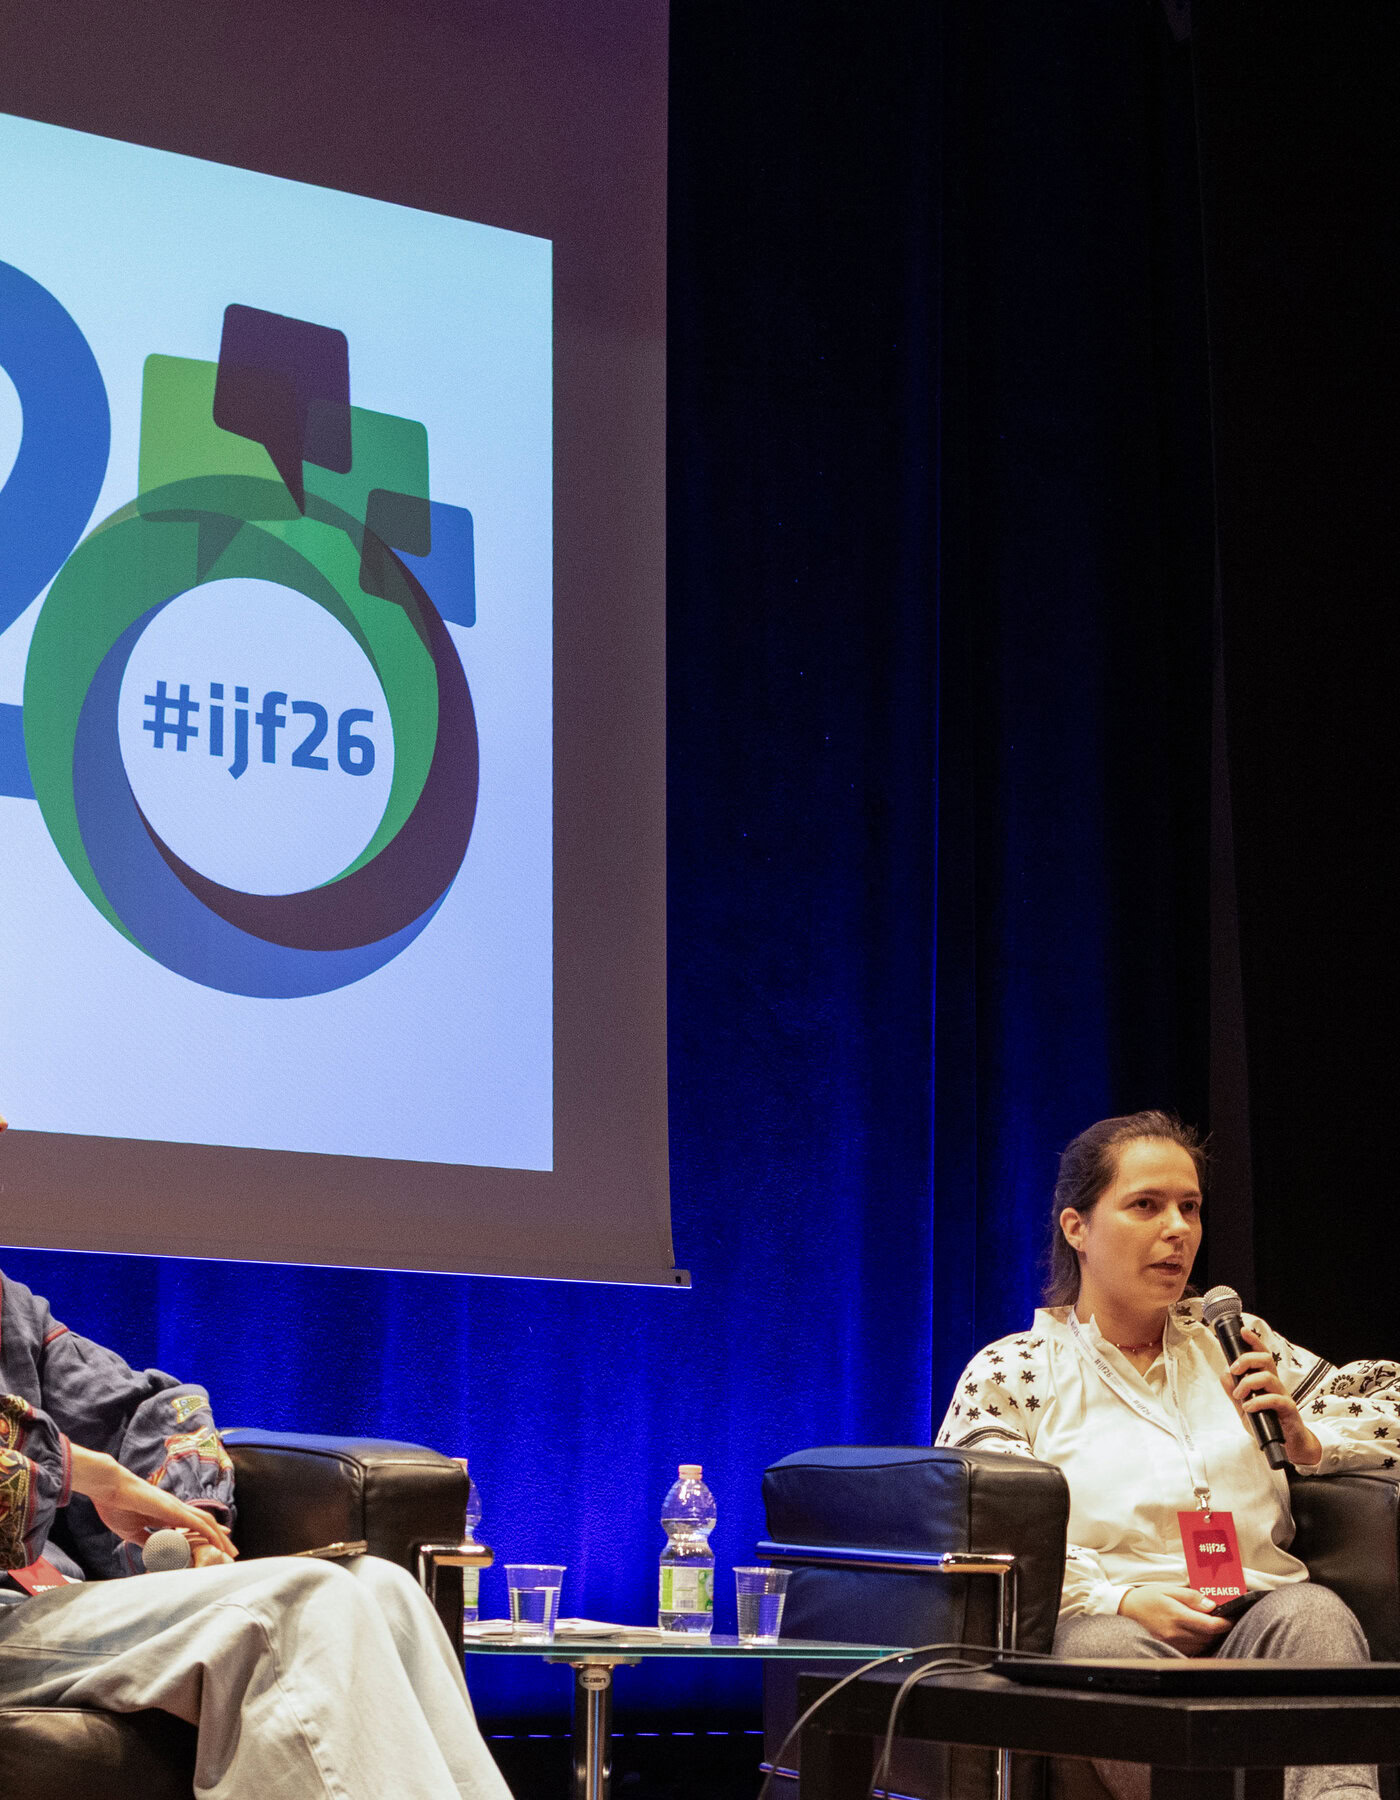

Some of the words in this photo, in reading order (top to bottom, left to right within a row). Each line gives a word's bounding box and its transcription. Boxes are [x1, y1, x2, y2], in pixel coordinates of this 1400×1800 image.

[142, 680, 377, 781] #ijf26
[1094, 1358, 1113, 1378] #ijf26
[1199, 1543, 1226, 1554] #ijf26
[1199, 1587, 1240, 1596] SPEAKER
